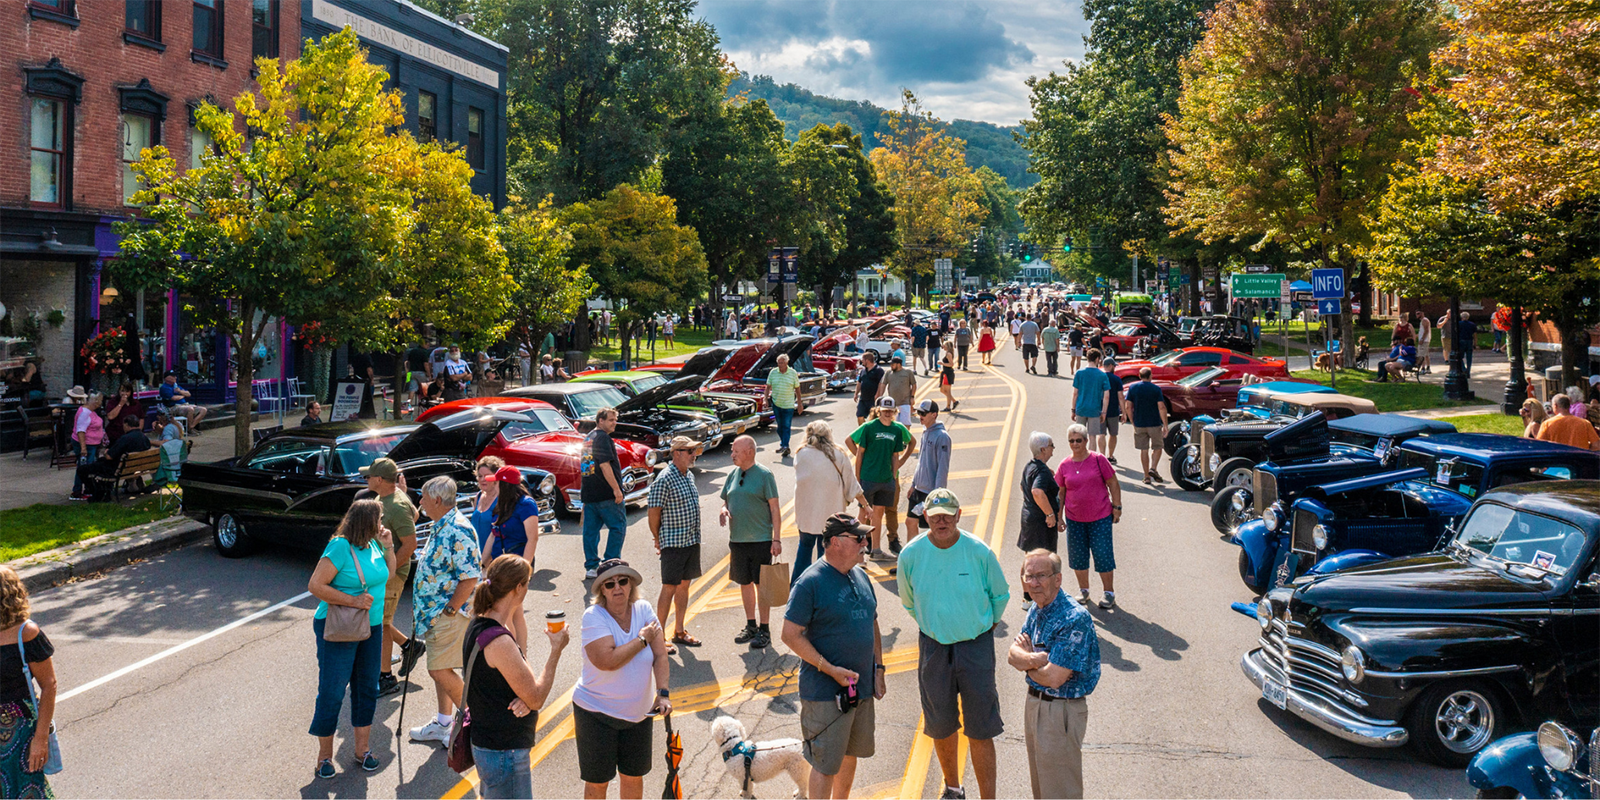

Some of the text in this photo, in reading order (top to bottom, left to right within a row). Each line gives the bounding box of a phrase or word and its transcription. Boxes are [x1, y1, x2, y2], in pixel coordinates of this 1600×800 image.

[344, 13, 365, 33] THE
[371, 24, 398, 47] BANK
[402, 37, 414, 53] OF
[418, 44, 480, 79] ELLICOTTVILLE
[1315, 275, 1341, 292] INFO
[851, 609, 868, 620] CREW
